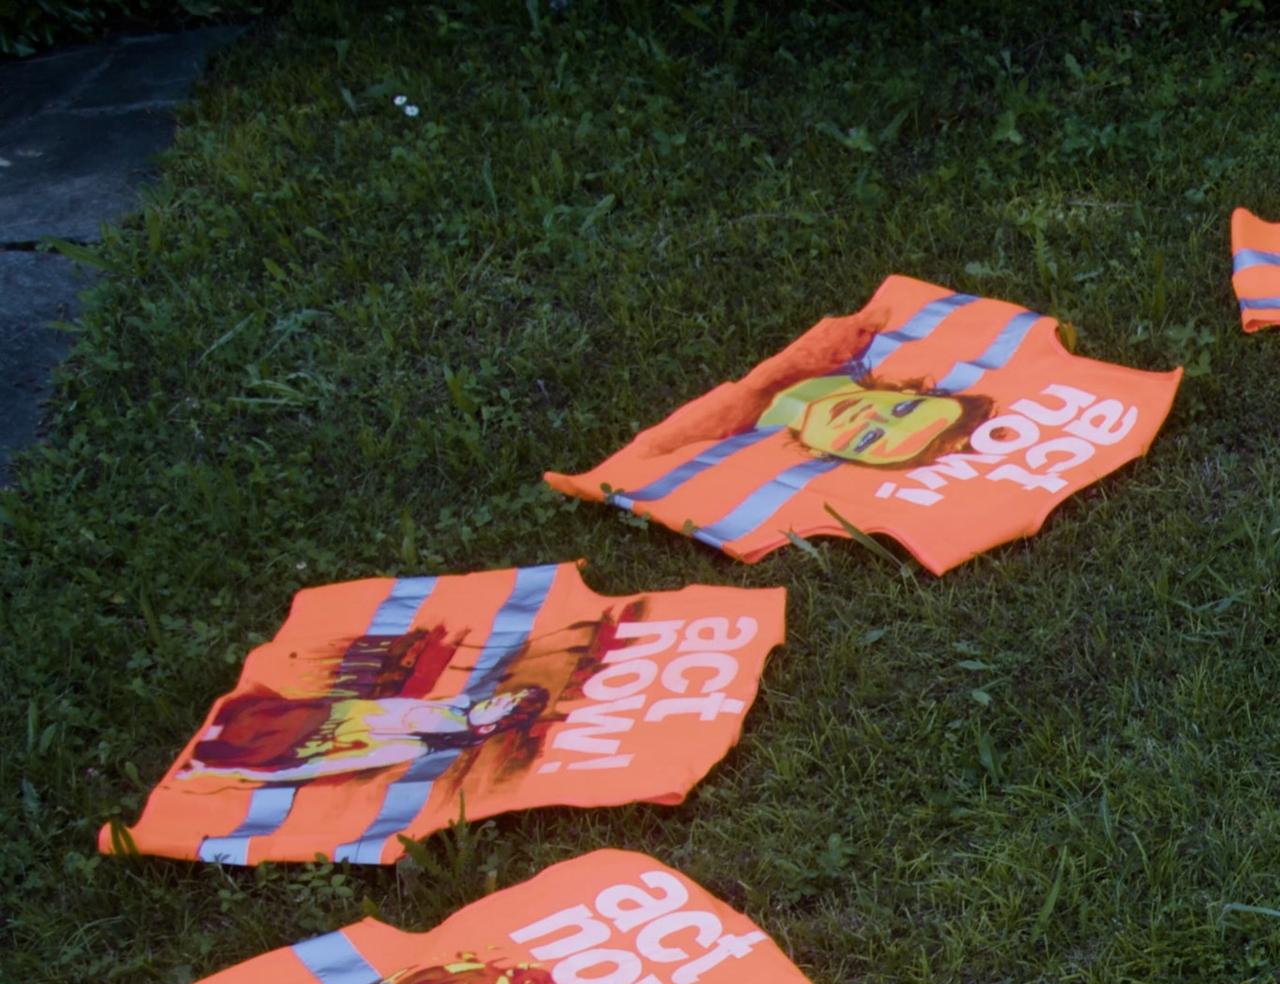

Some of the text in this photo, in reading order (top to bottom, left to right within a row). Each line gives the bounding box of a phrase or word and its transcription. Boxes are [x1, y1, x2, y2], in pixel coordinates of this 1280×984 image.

[876, 384, 1098, 507] now!
[987, 397, 1138, 494] act
[537, 616, 690, 775] now!
[645, 615, 758, 723] act
